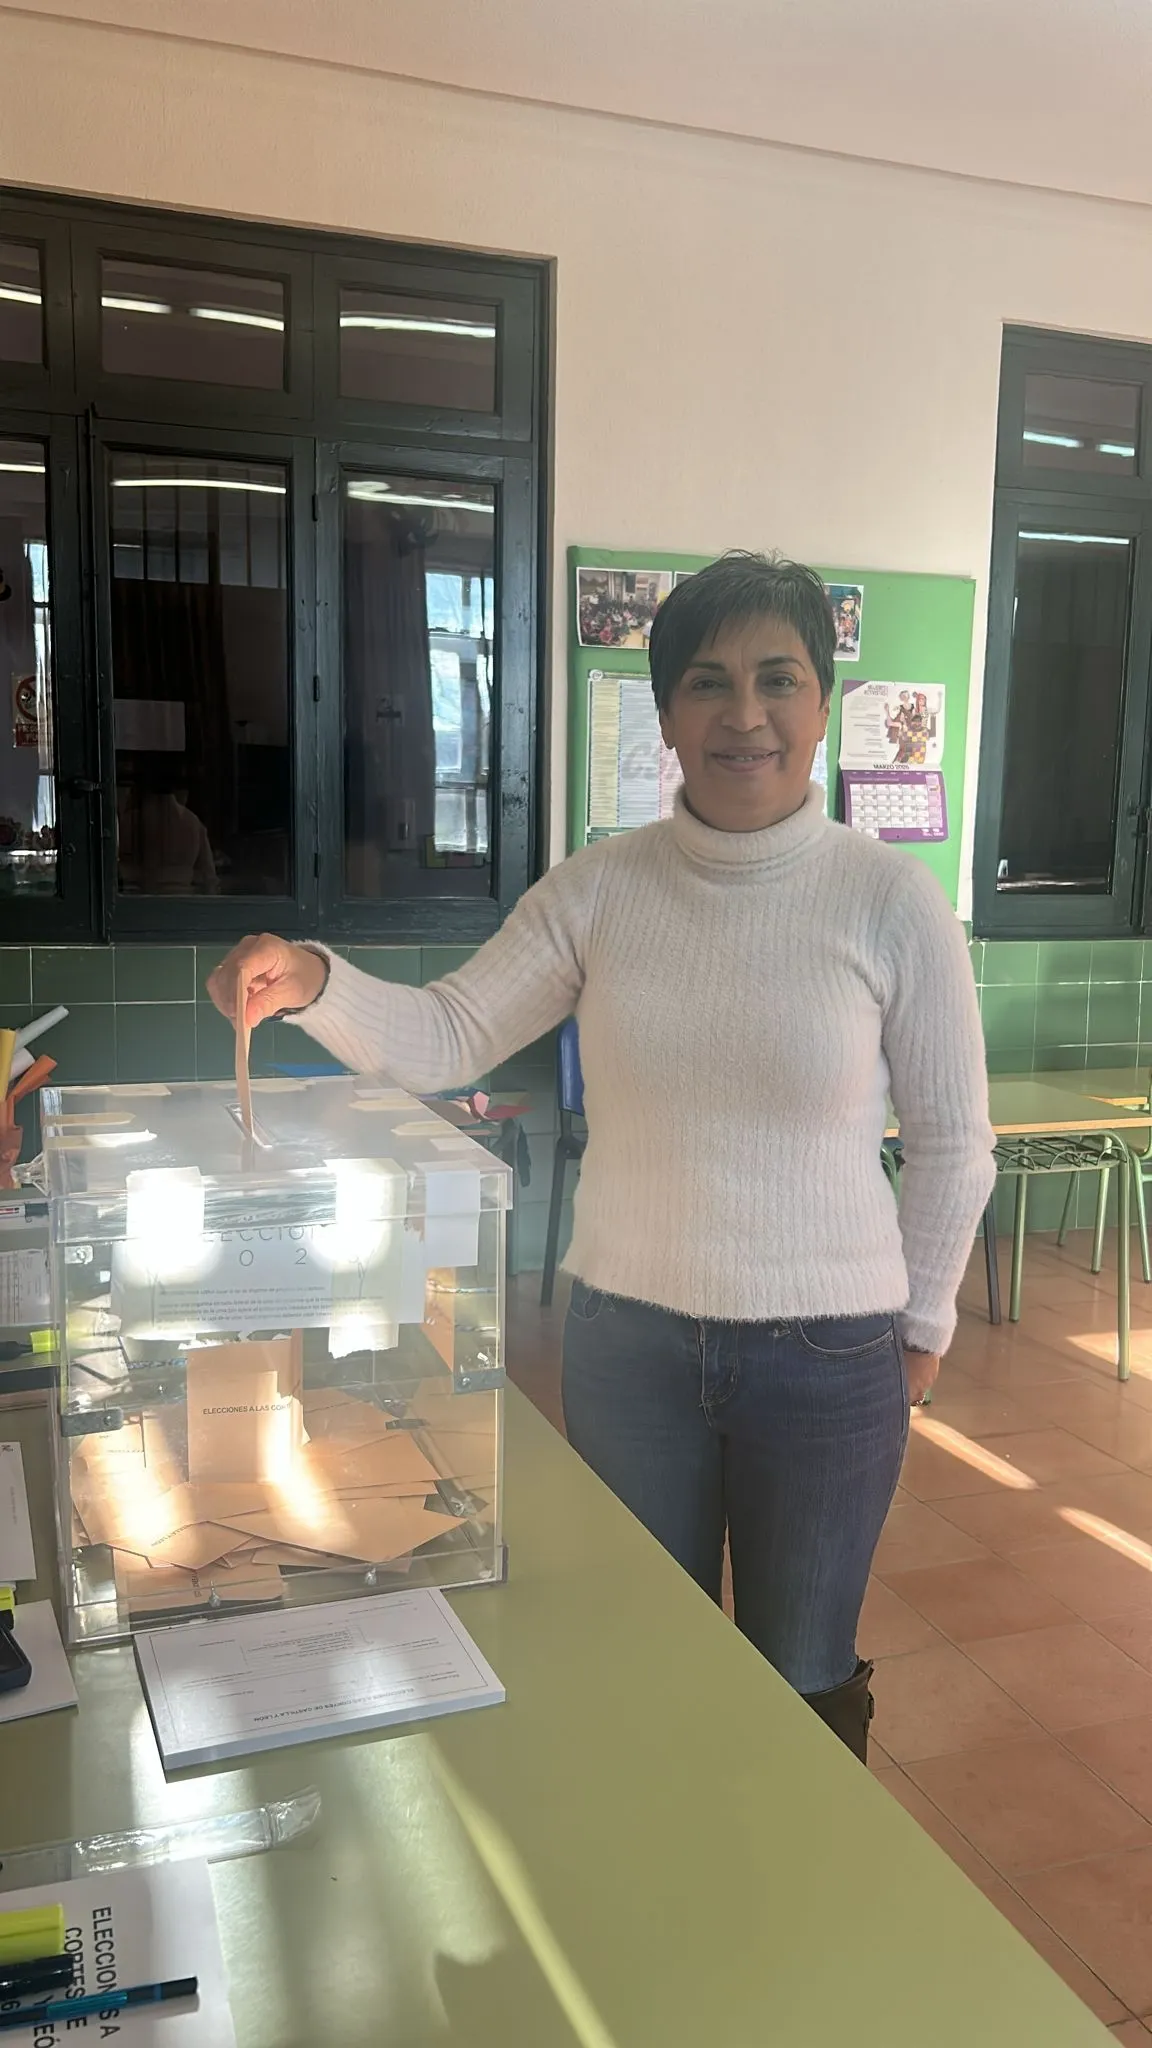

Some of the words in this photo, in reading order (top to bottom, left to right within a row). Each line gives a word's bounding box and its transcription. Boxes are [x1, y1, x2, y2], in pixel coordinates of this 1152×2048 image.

[203, 1406, 248, 1415] ELECCIONES
[255, 1404, 269, 1412] LAS
[92, 1906, 120, 2020] ELECCIONS
[100, 2025, 121, 2039] A
